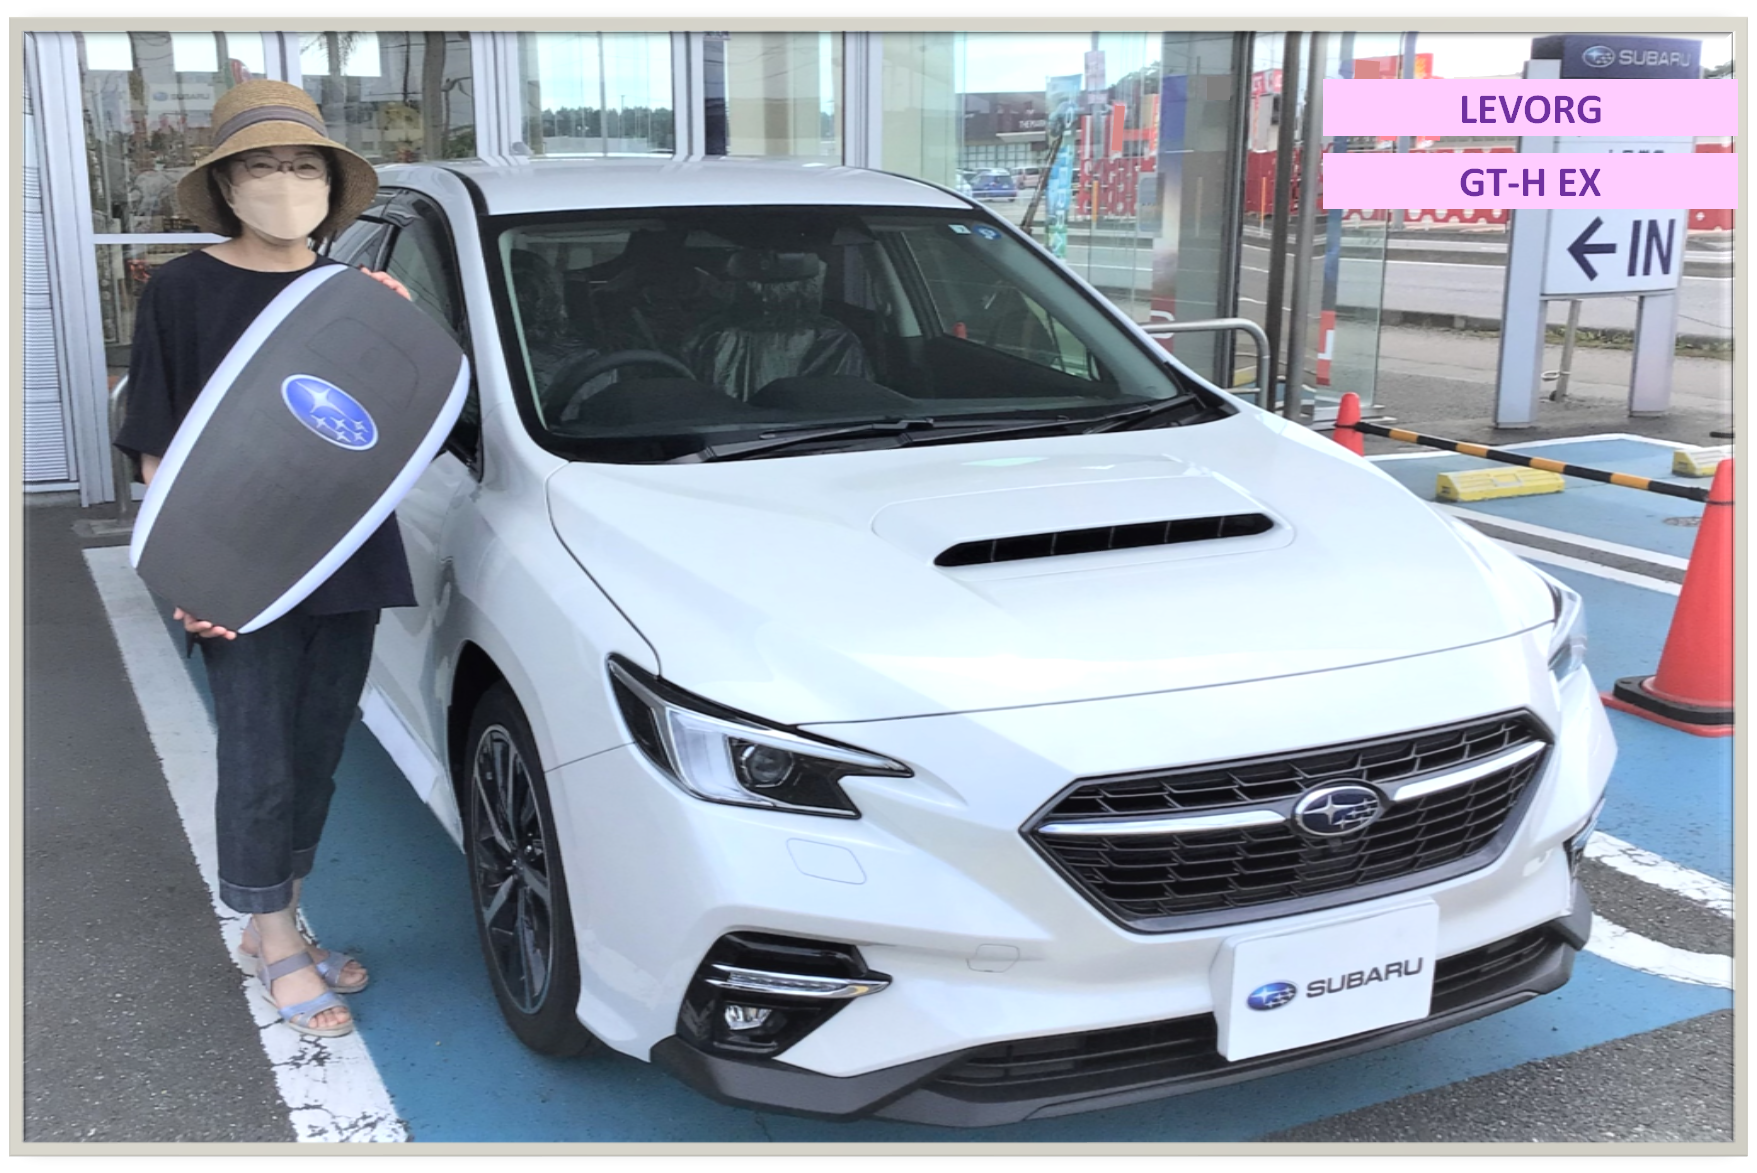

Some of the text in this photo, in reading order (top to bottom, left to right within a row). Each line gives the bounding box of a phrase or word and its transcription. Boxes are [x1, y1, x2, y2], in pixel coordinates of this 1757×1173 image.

[1618, 49, 1691, 66] SUBARU
[1627, 219, 1676, 277] IN
[1306, 957, 1423, 998] SUBARU
